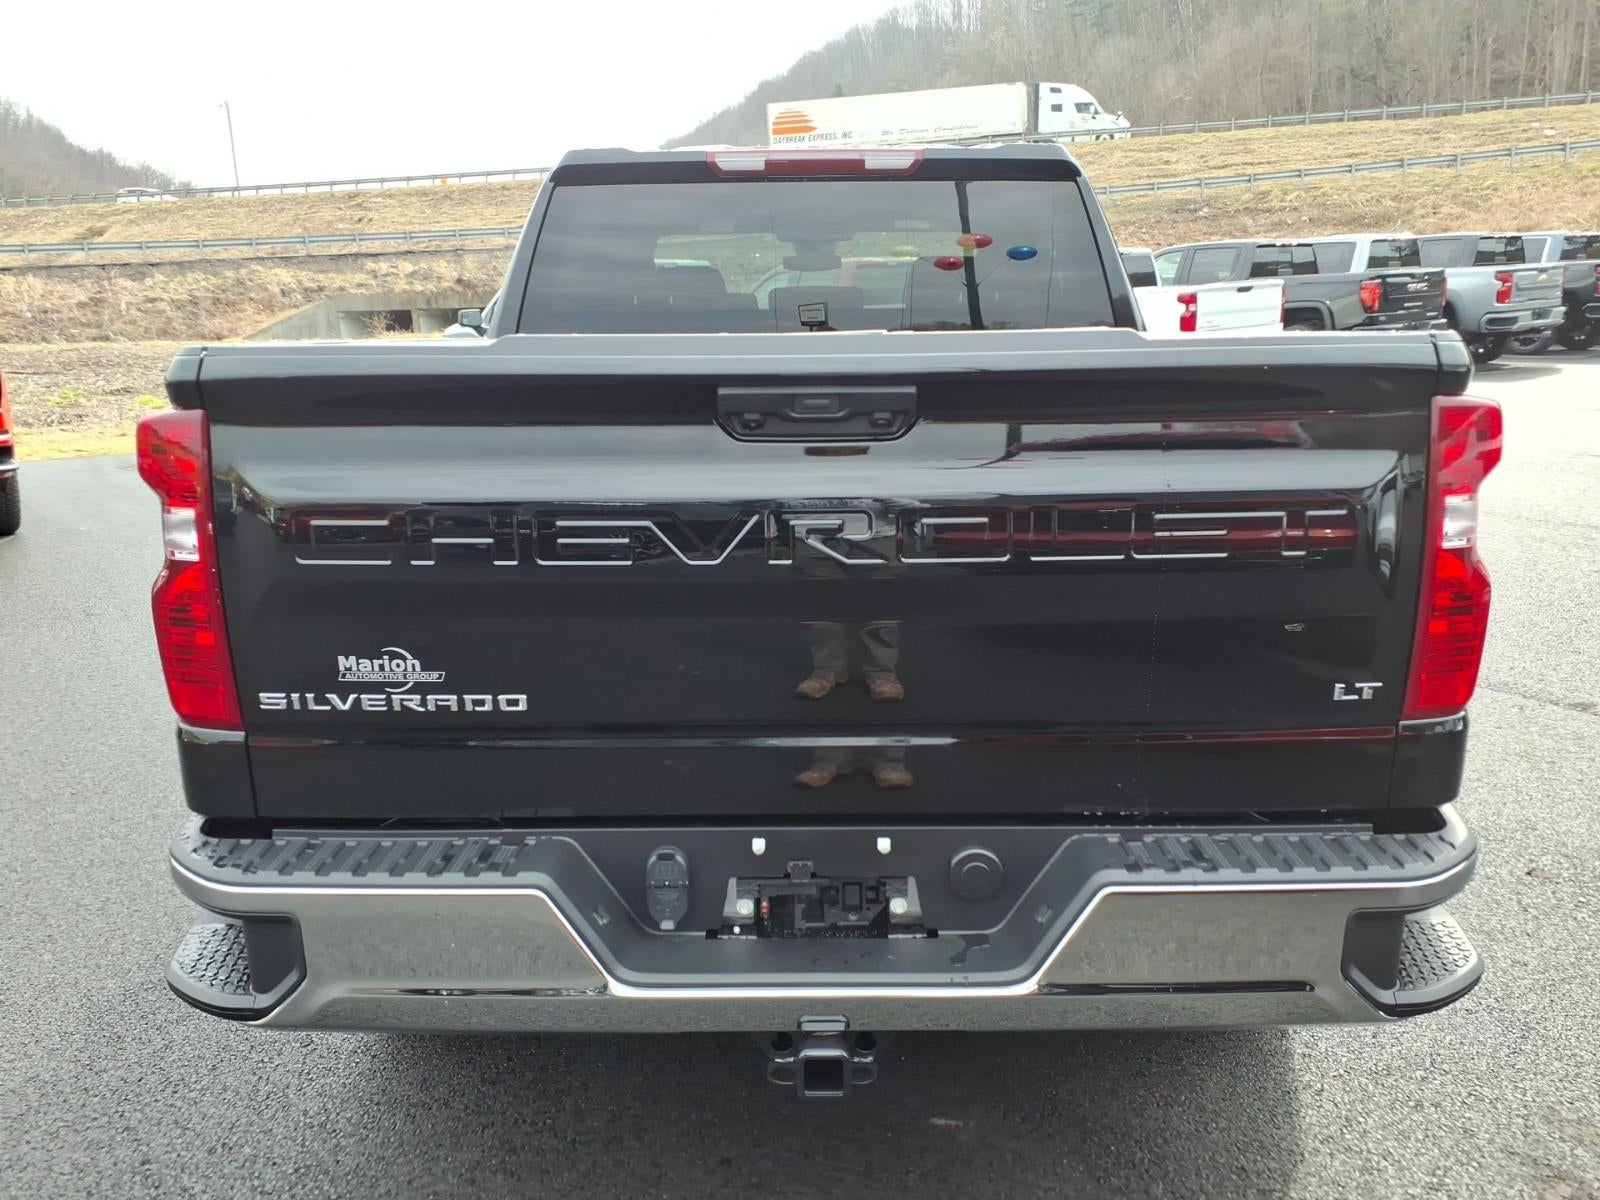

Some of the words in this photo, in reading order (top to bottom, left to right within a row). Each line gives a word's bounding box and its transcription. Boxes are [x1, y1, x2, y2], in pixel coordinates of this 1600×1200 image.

[772, 135, 806, 145] DAYBREAK
[293, 505, 1352, 567] CHEVROLET
[337, 655, 421, 672] Marion
[1333, 682, 1383, 701] LT
[258, 692, 528, 712] SILVERADO
